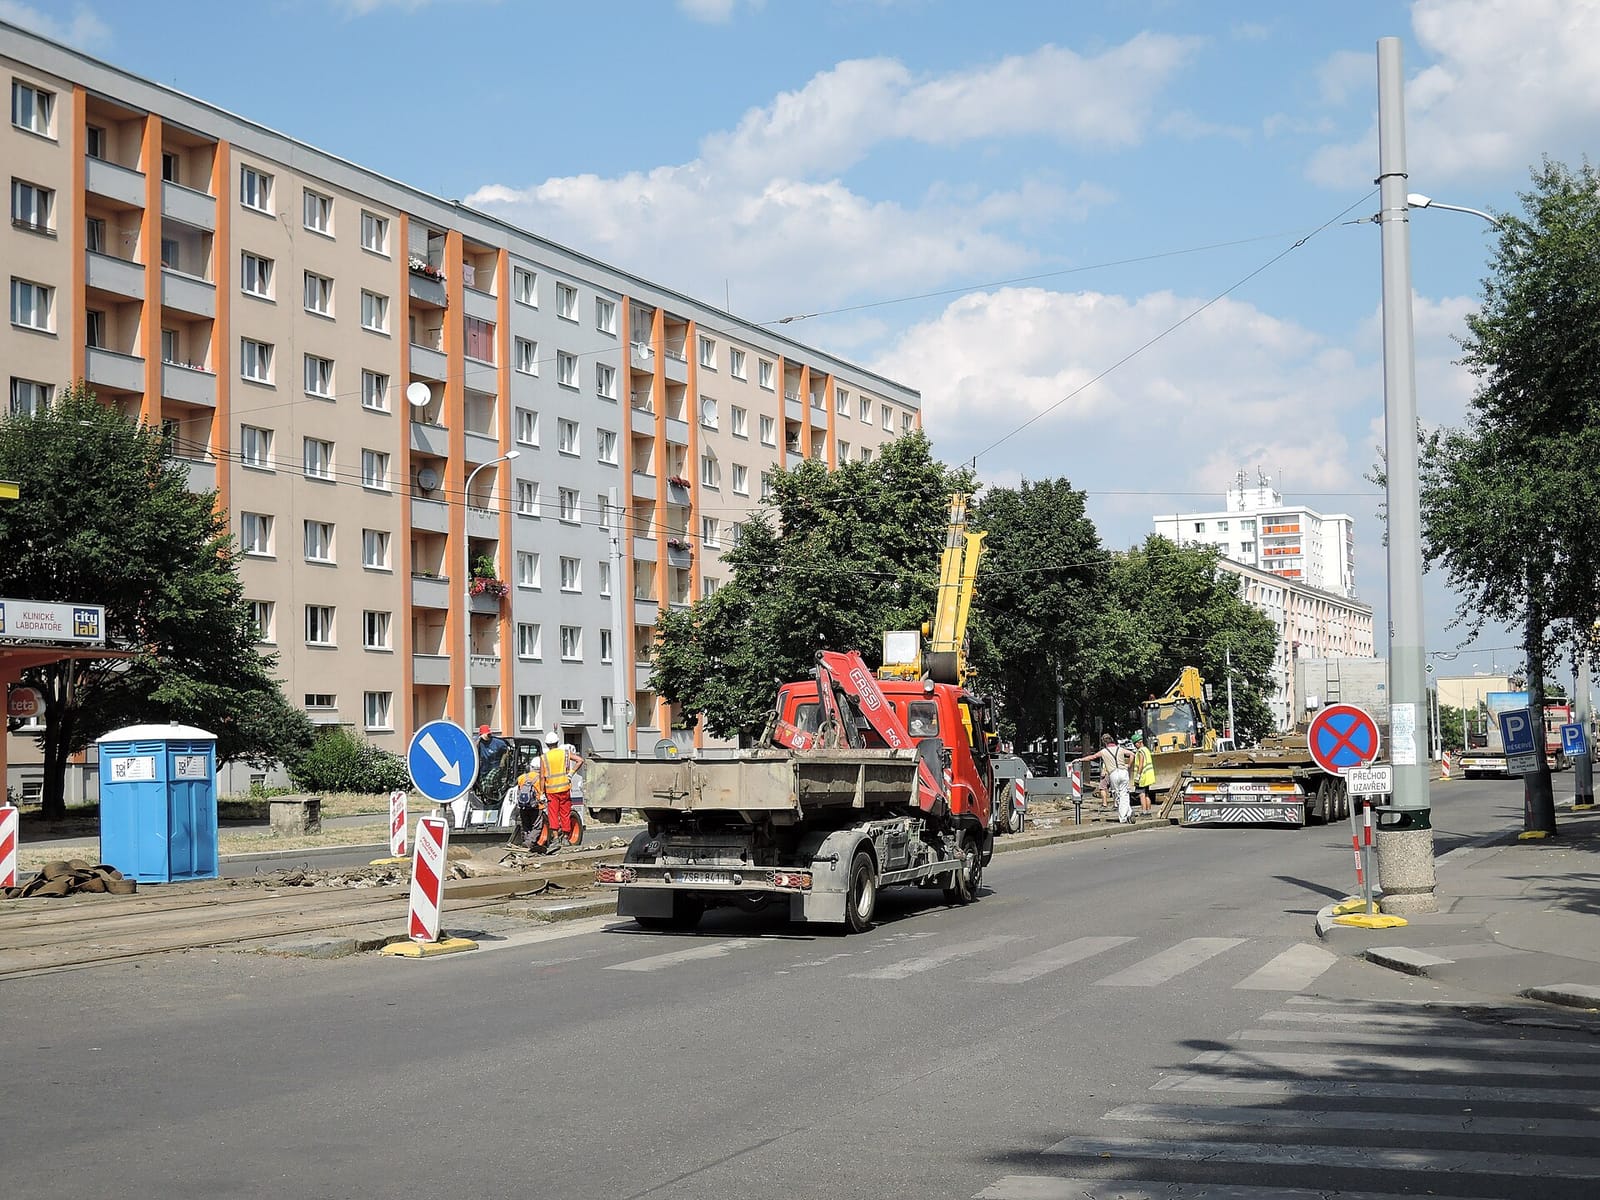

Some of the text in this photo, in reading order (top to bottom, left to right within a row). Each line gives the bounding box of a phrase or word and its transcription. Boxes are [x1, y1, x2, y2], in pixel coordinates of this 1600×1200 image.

[23, 611, 55, 621] KLINICKÉ
[75, 611, 98, 625] city
[15, 620, 62, 632] LABORATOŘE
[74, 622, 97, 636] lab
[851, 669, 879, 709] FASSI
[11, 699, 35, 711] teta
[1506, 716, 1525, 742] P
[886, 727, 901, 746] F65
[1566, 727, 1579, 746] P
[1353, 770, 1387, 781] PŘECHOD
[1353, 781, 1387, 792] UZAVŘEN
